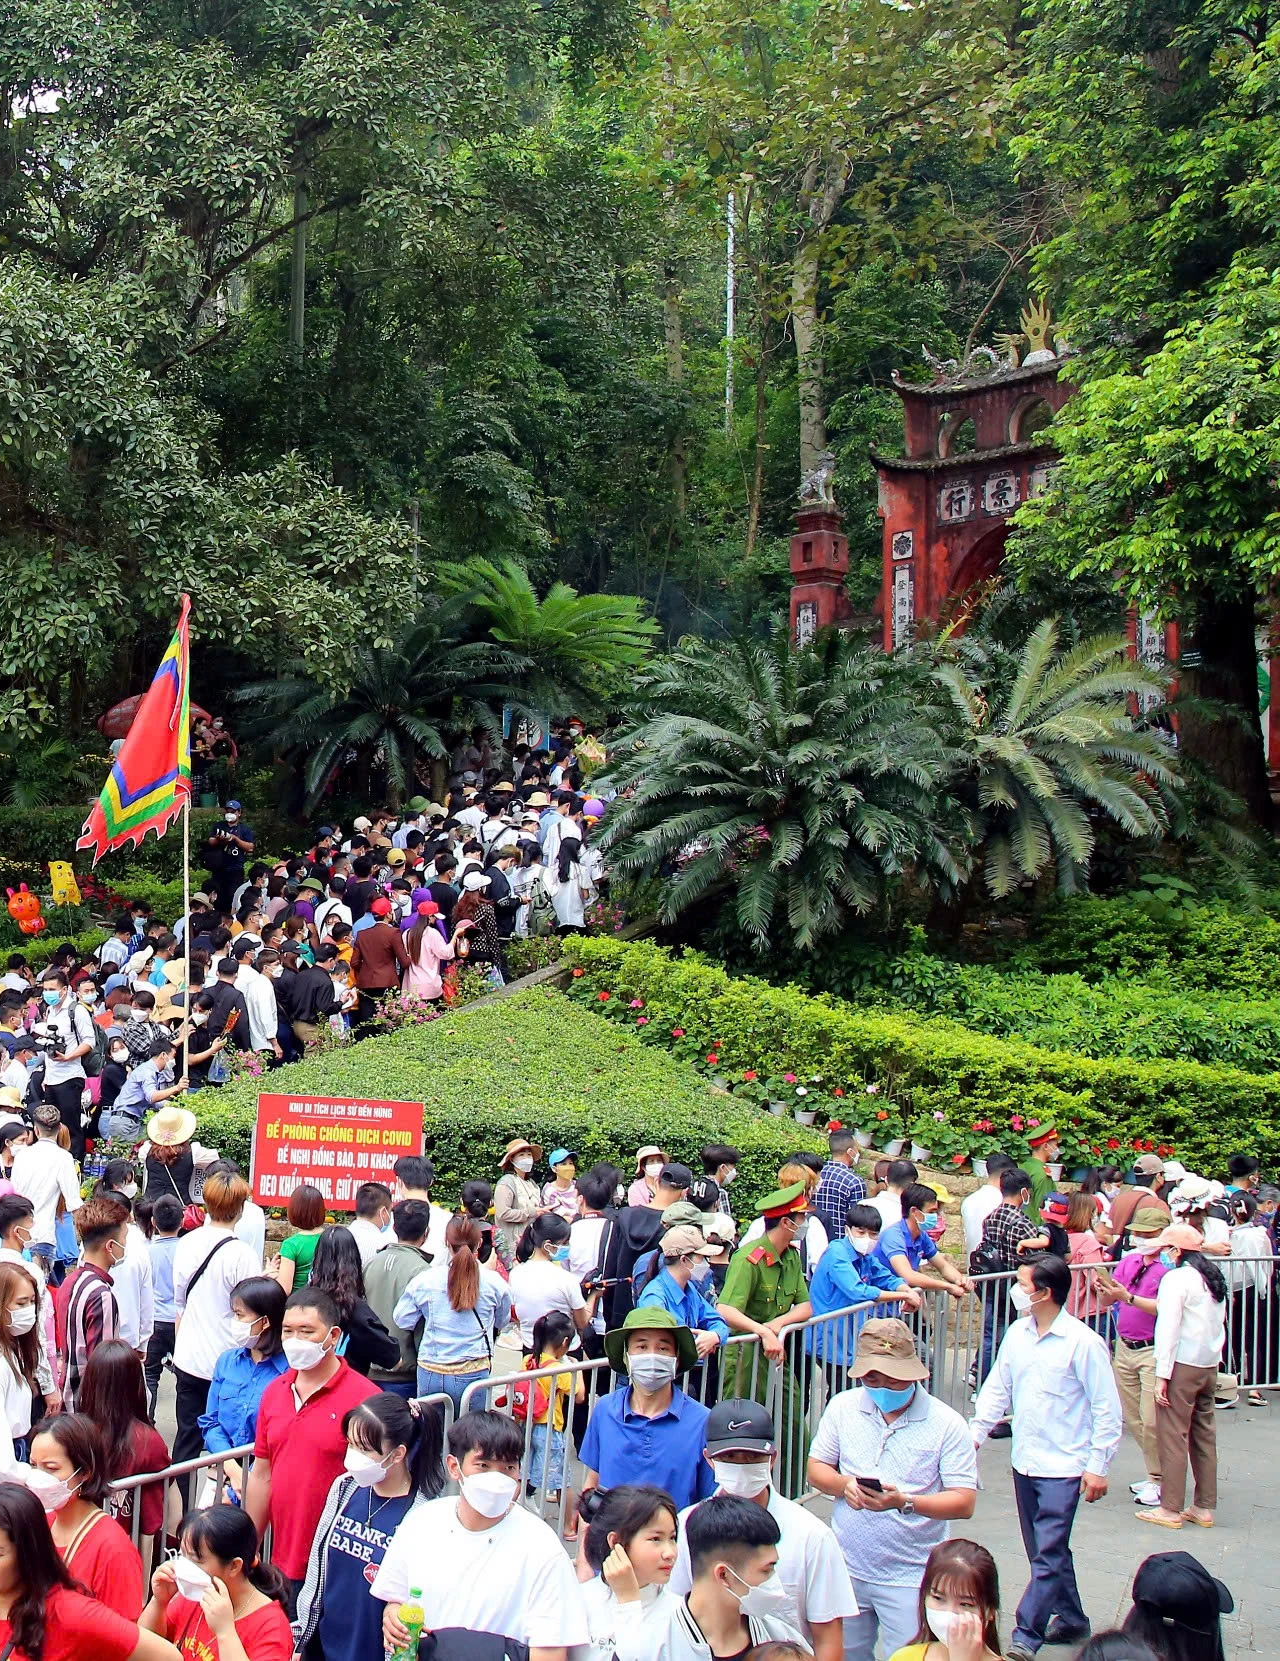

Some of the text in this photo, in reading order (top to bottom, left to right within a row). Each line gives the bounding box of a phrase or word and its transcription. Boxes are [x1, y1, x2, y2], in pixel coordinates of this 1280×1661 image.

[289, 1102, 303, 1113] KHU
[313, 1102, 329, 1115] TÍCH
[330, 1104, 346, 1118] LỊCH
[282, 1121, 317, 1141] PHÒNG
[319, 1122, 354, 1143] CHỐNG
[356, 1128, 380, 1148] DỊCH
[382, 1129, 412, 1147] COVID
[290, 1148, 311, 1169] NGHỊ
[357, 1152, 369, 1169] DU
[260, 1174, 277, 1197] ĐEO
[336, 1173, 353, 1201] GIỮ
[329, 1531, 374, 1563] BABE
